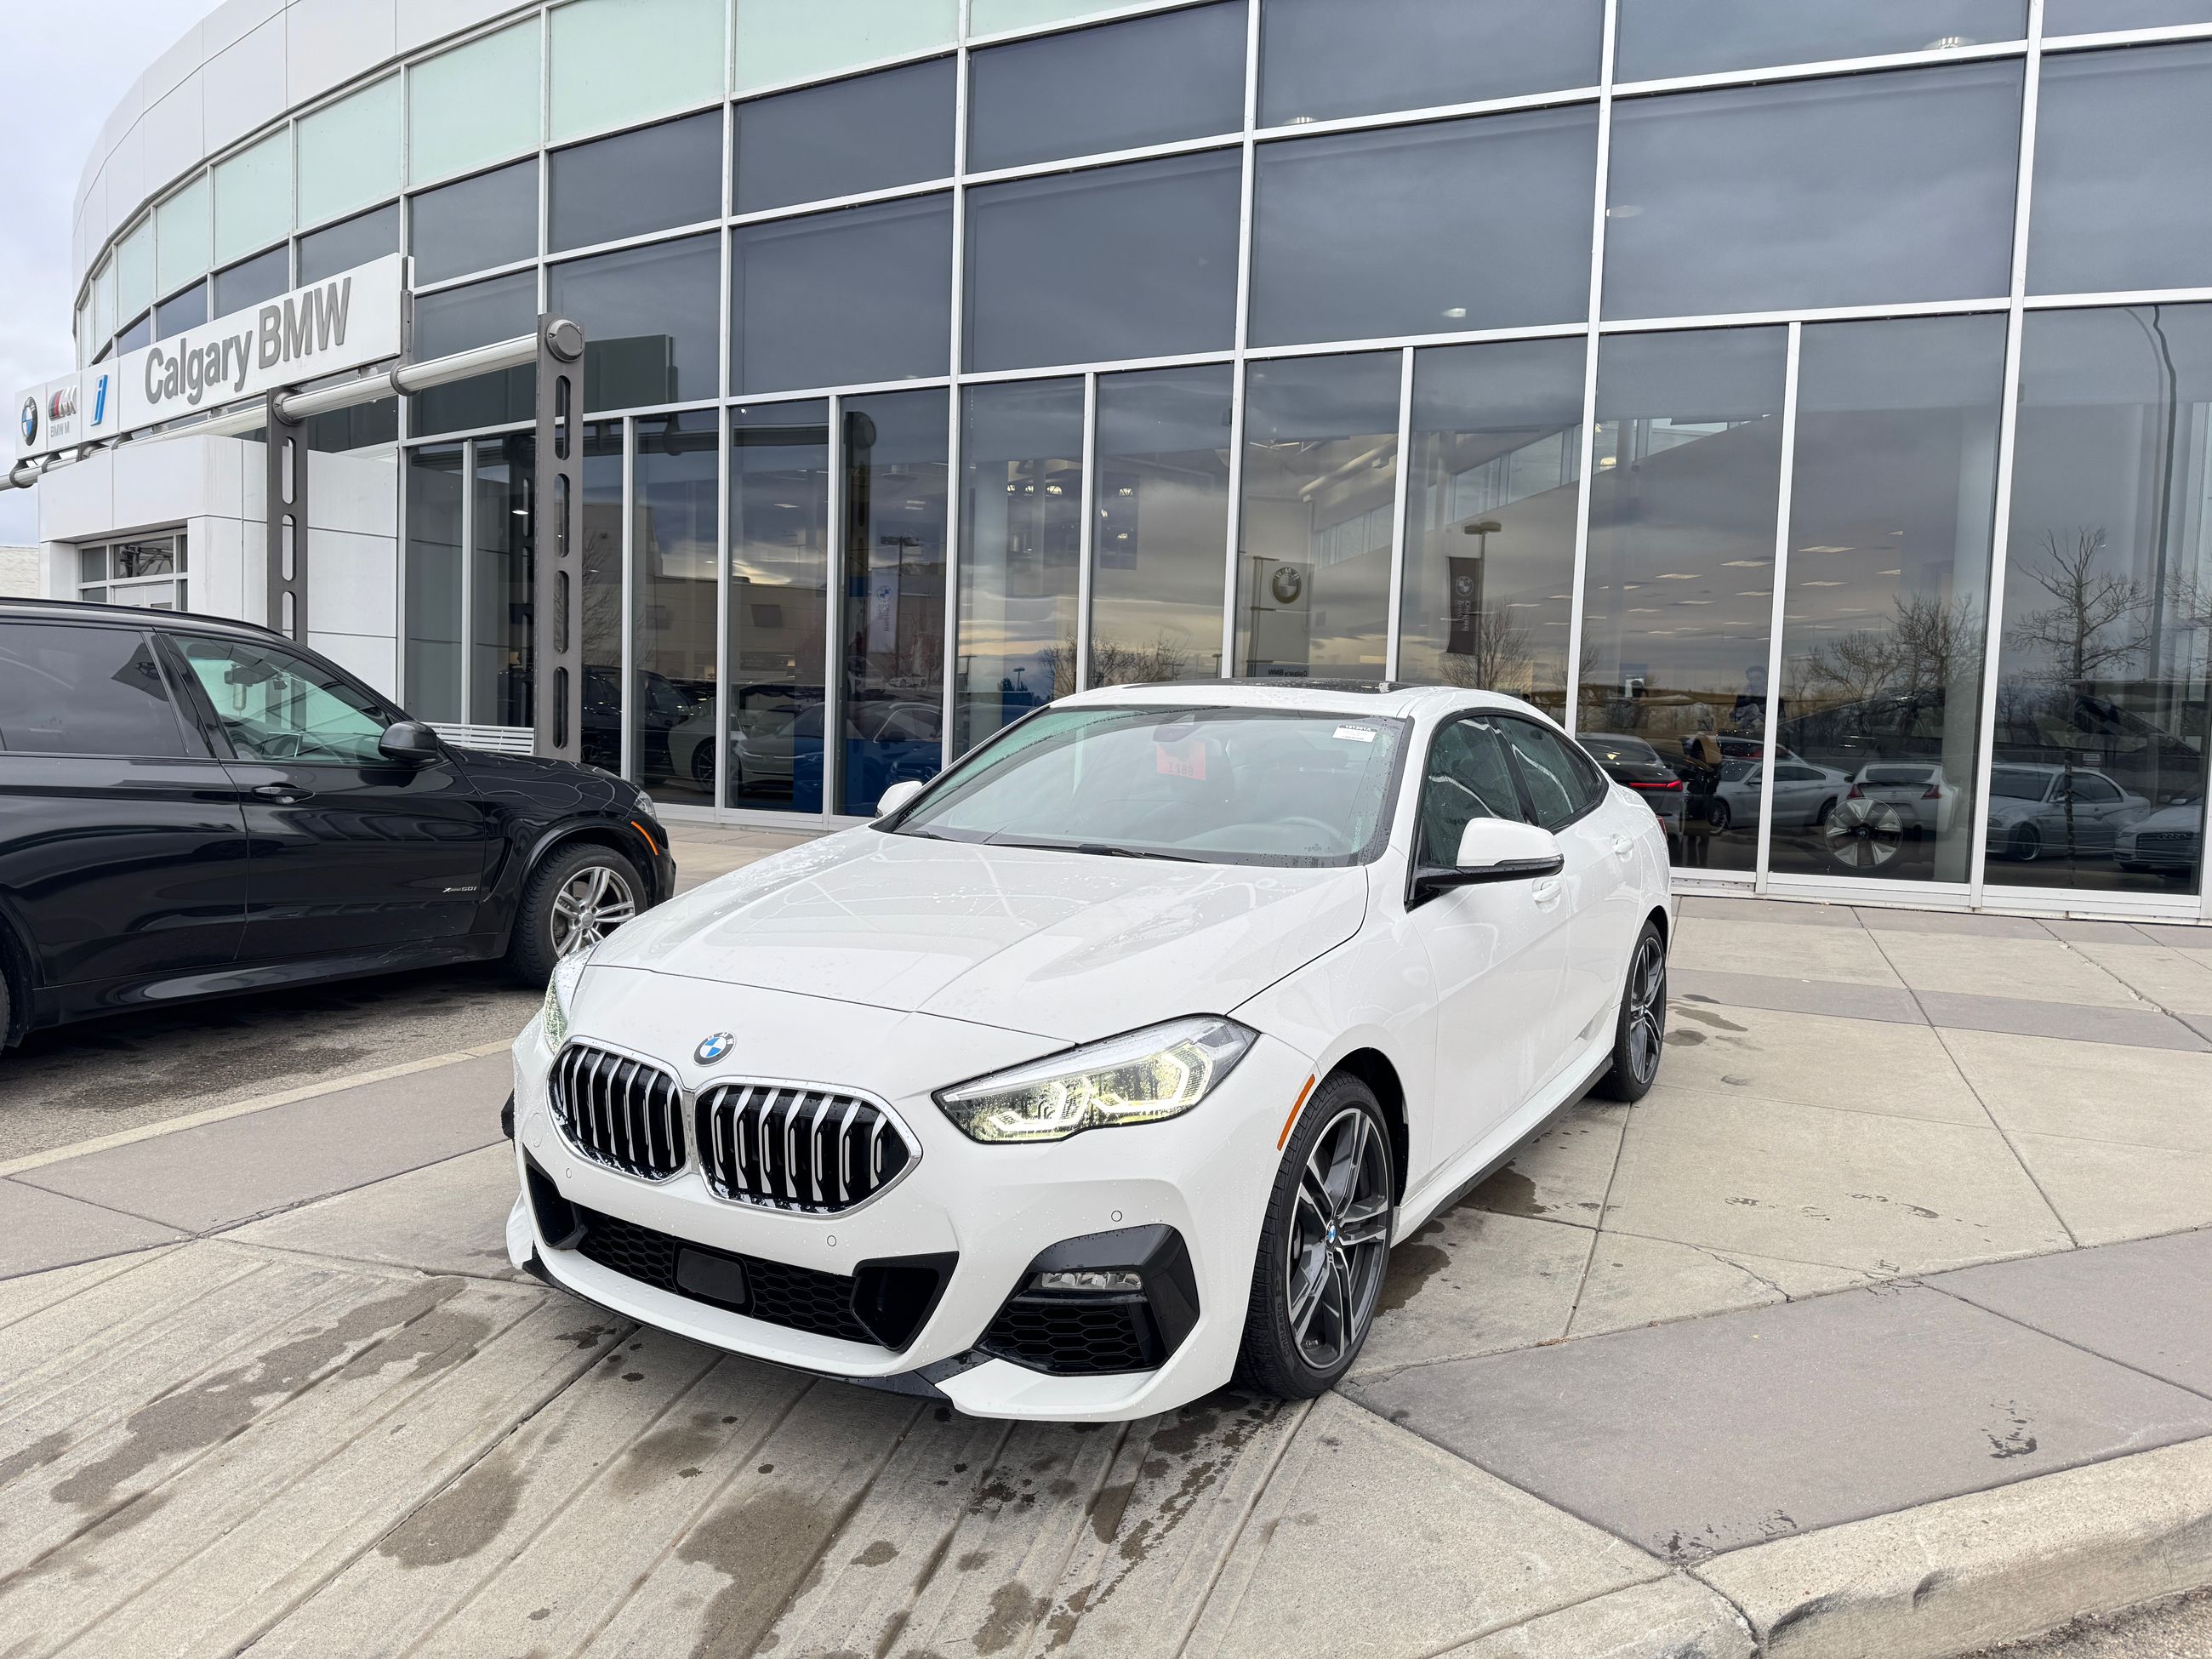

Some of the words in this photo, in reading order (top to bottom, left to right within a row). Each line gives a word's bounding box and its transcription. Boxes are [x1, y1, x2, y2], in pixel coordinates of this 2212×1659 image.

[144, 330, 254, 405] Calgary
[258, 276, 351, 369] BMW
[51, 423, 64, 438] BMW
[65, 421, 70, 434] M
